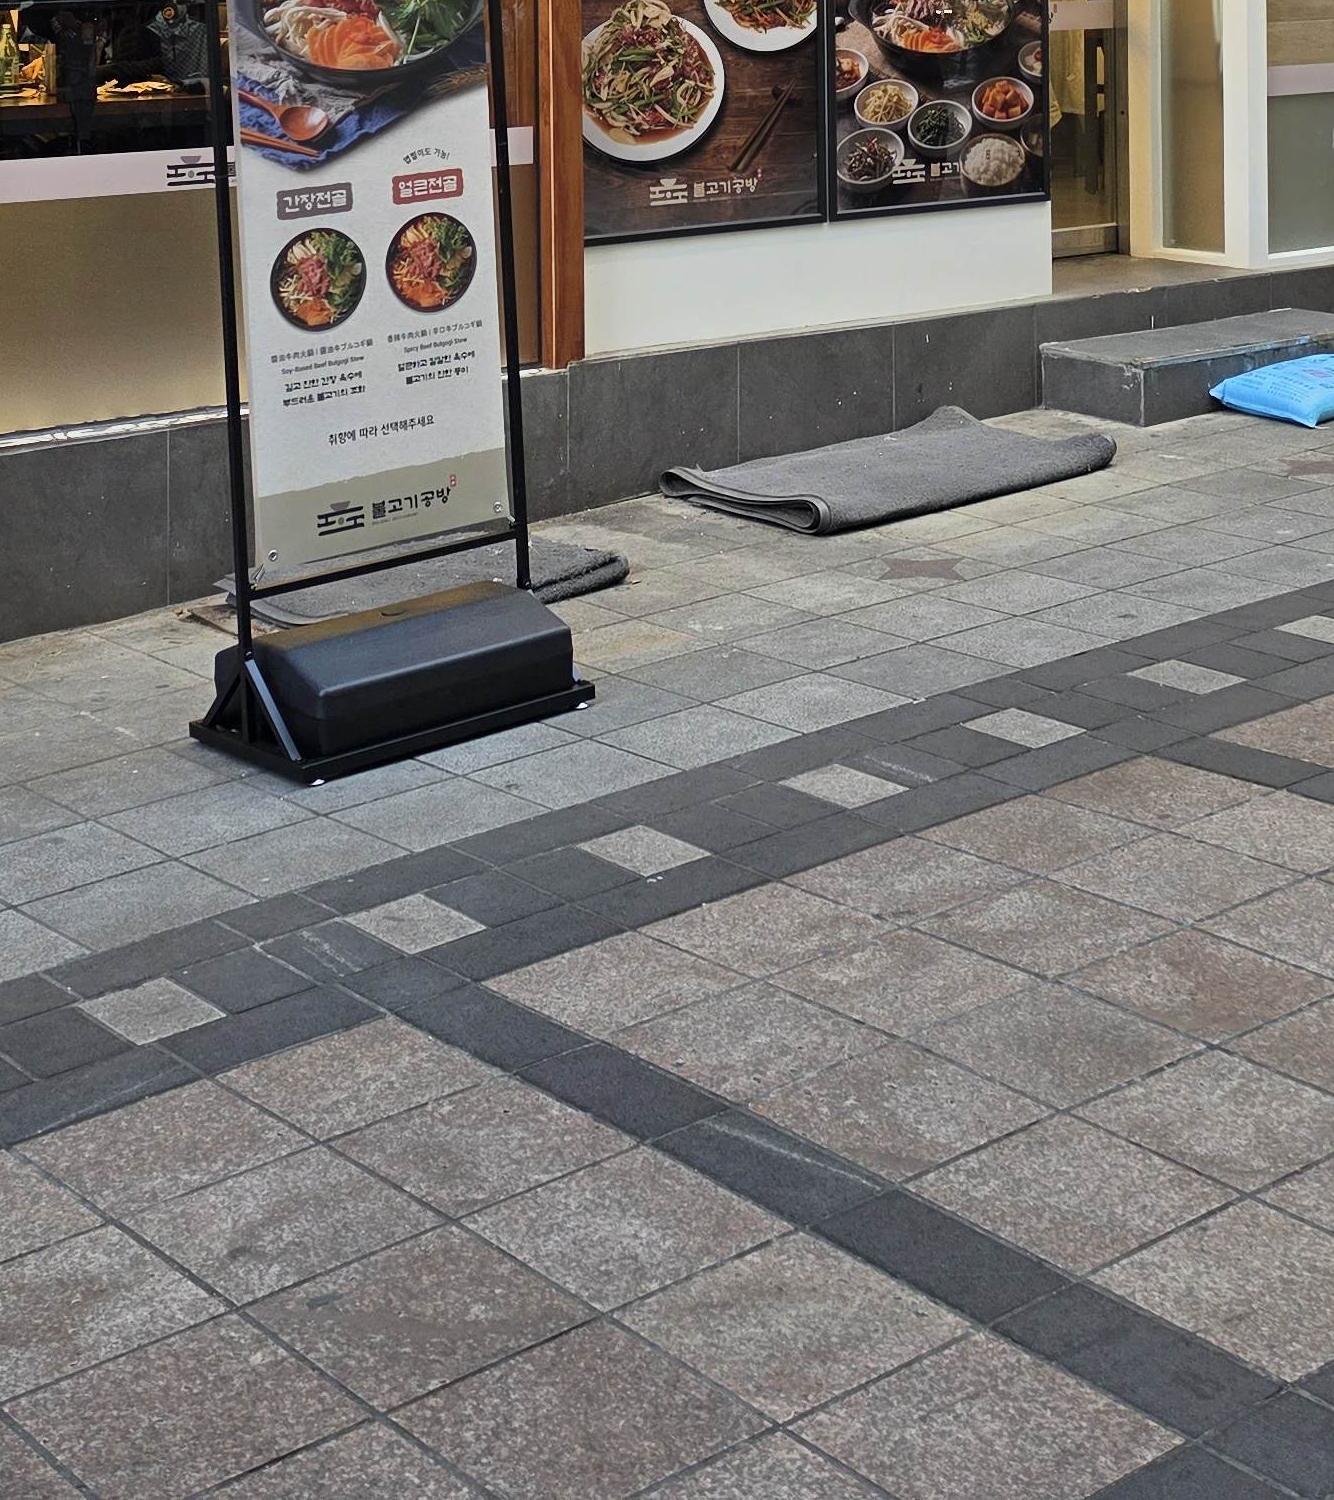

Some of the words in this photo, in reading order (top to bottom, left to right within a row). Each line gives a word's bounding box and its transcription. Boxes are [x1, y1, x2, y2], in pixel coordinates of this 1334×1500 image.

[397, 174, 458, 198] 얼큰전골
[693, 176, 759, 198] 불고기공방
[281, 188, 348, 214] 간장전골
[328, 428, 357, 447] 취향에
[359, 424, 378, 440] 따라
[380, 414, 435, 438] 선택해주세요
[372, 486, 451, 520] 불고기공방
